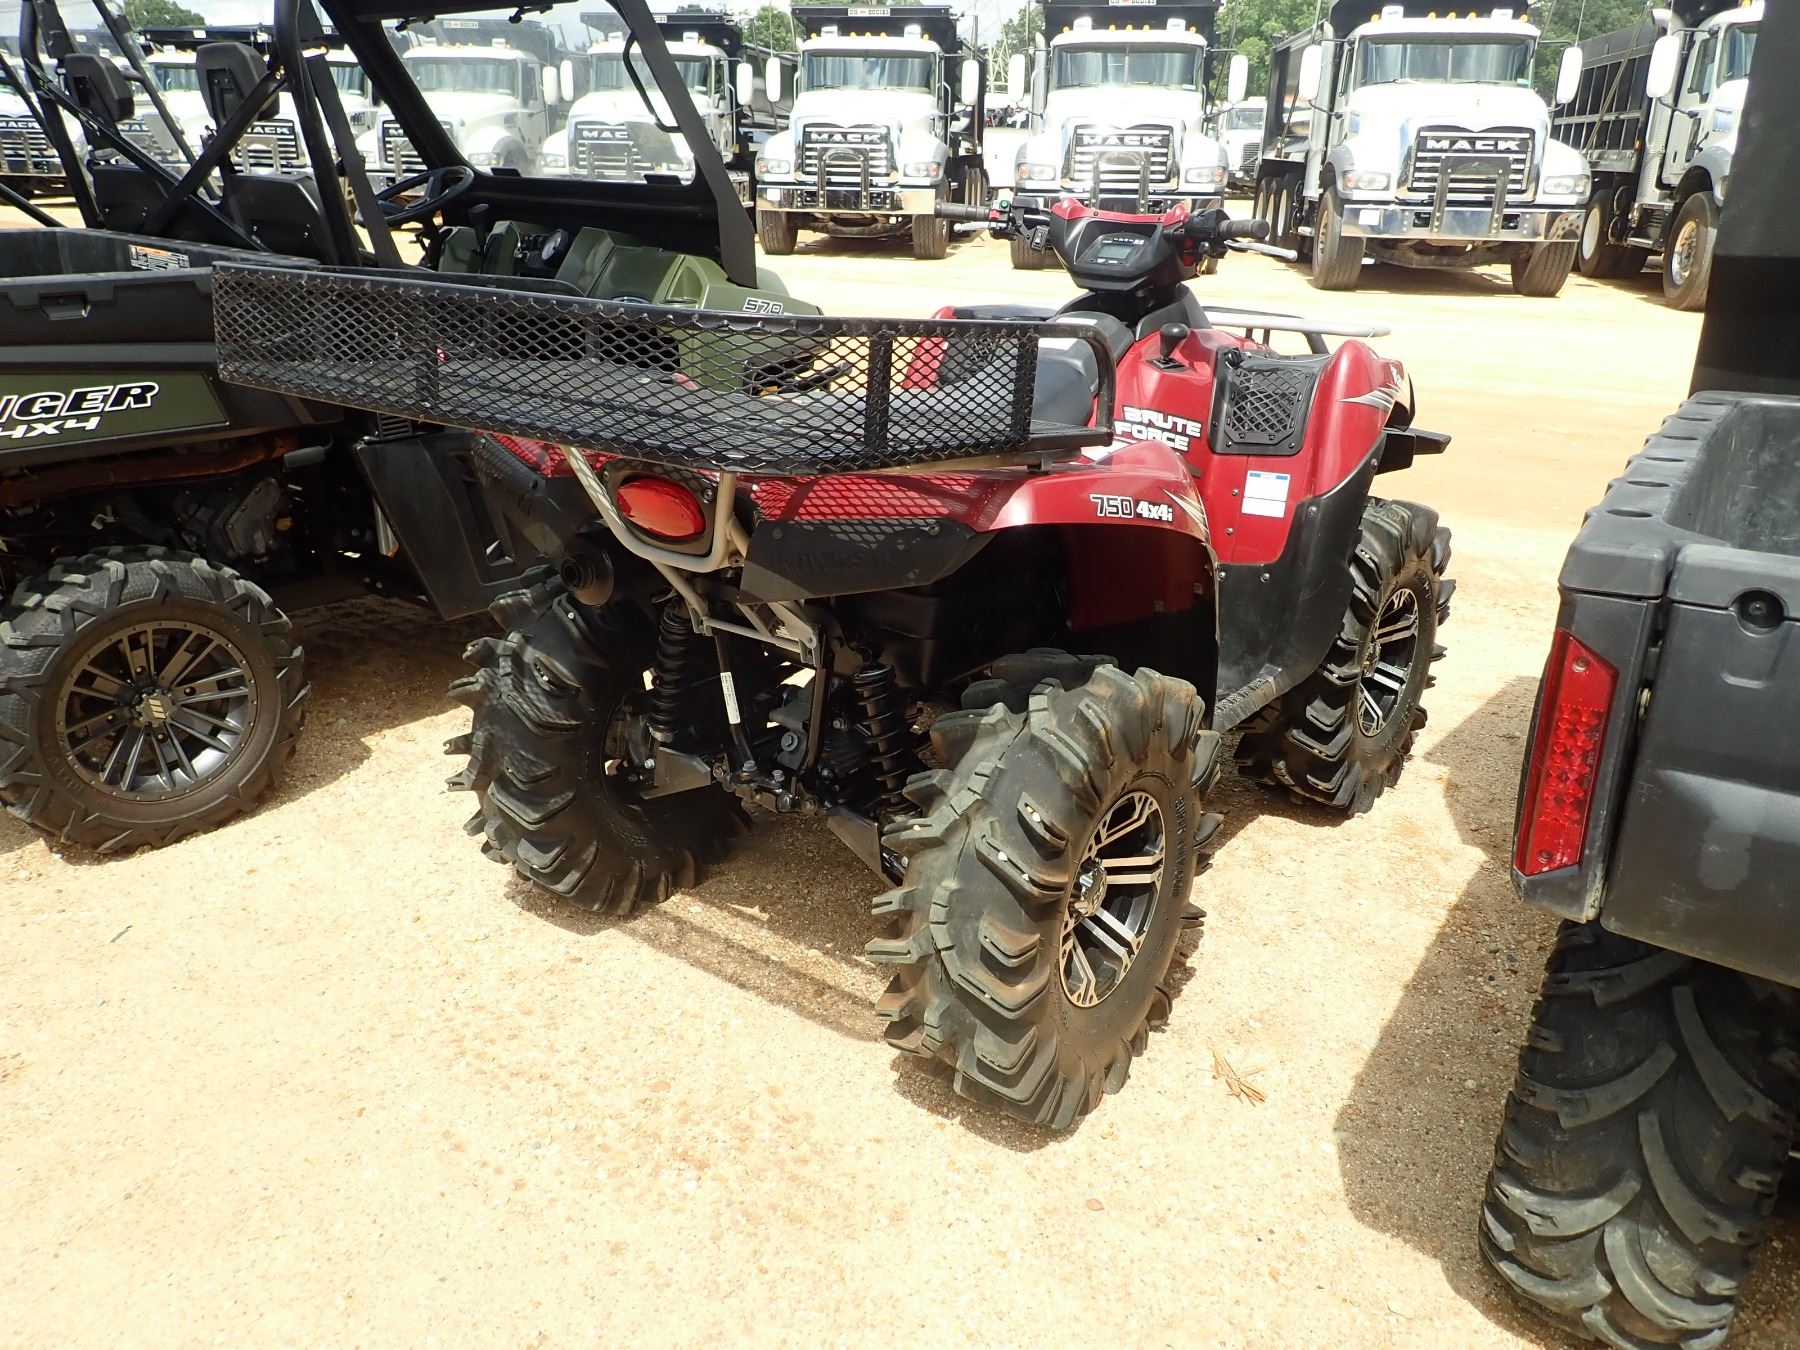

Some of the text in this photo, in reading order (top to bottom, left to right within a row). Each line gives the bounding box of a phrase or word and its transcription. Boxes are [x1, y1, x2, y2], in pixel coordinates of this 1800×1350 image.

[810, 132, 880, 143] MACK
[1082, 135, 1163, 145] MACK
[1426, 139, 1521, 151] MACK
[743, 297, 784, 315] 570
[1123, 406, 1202, 438] BRUTE
[1113, 420, 1190, 452] FORCE
[1090, 493, 1134, 518] 750
